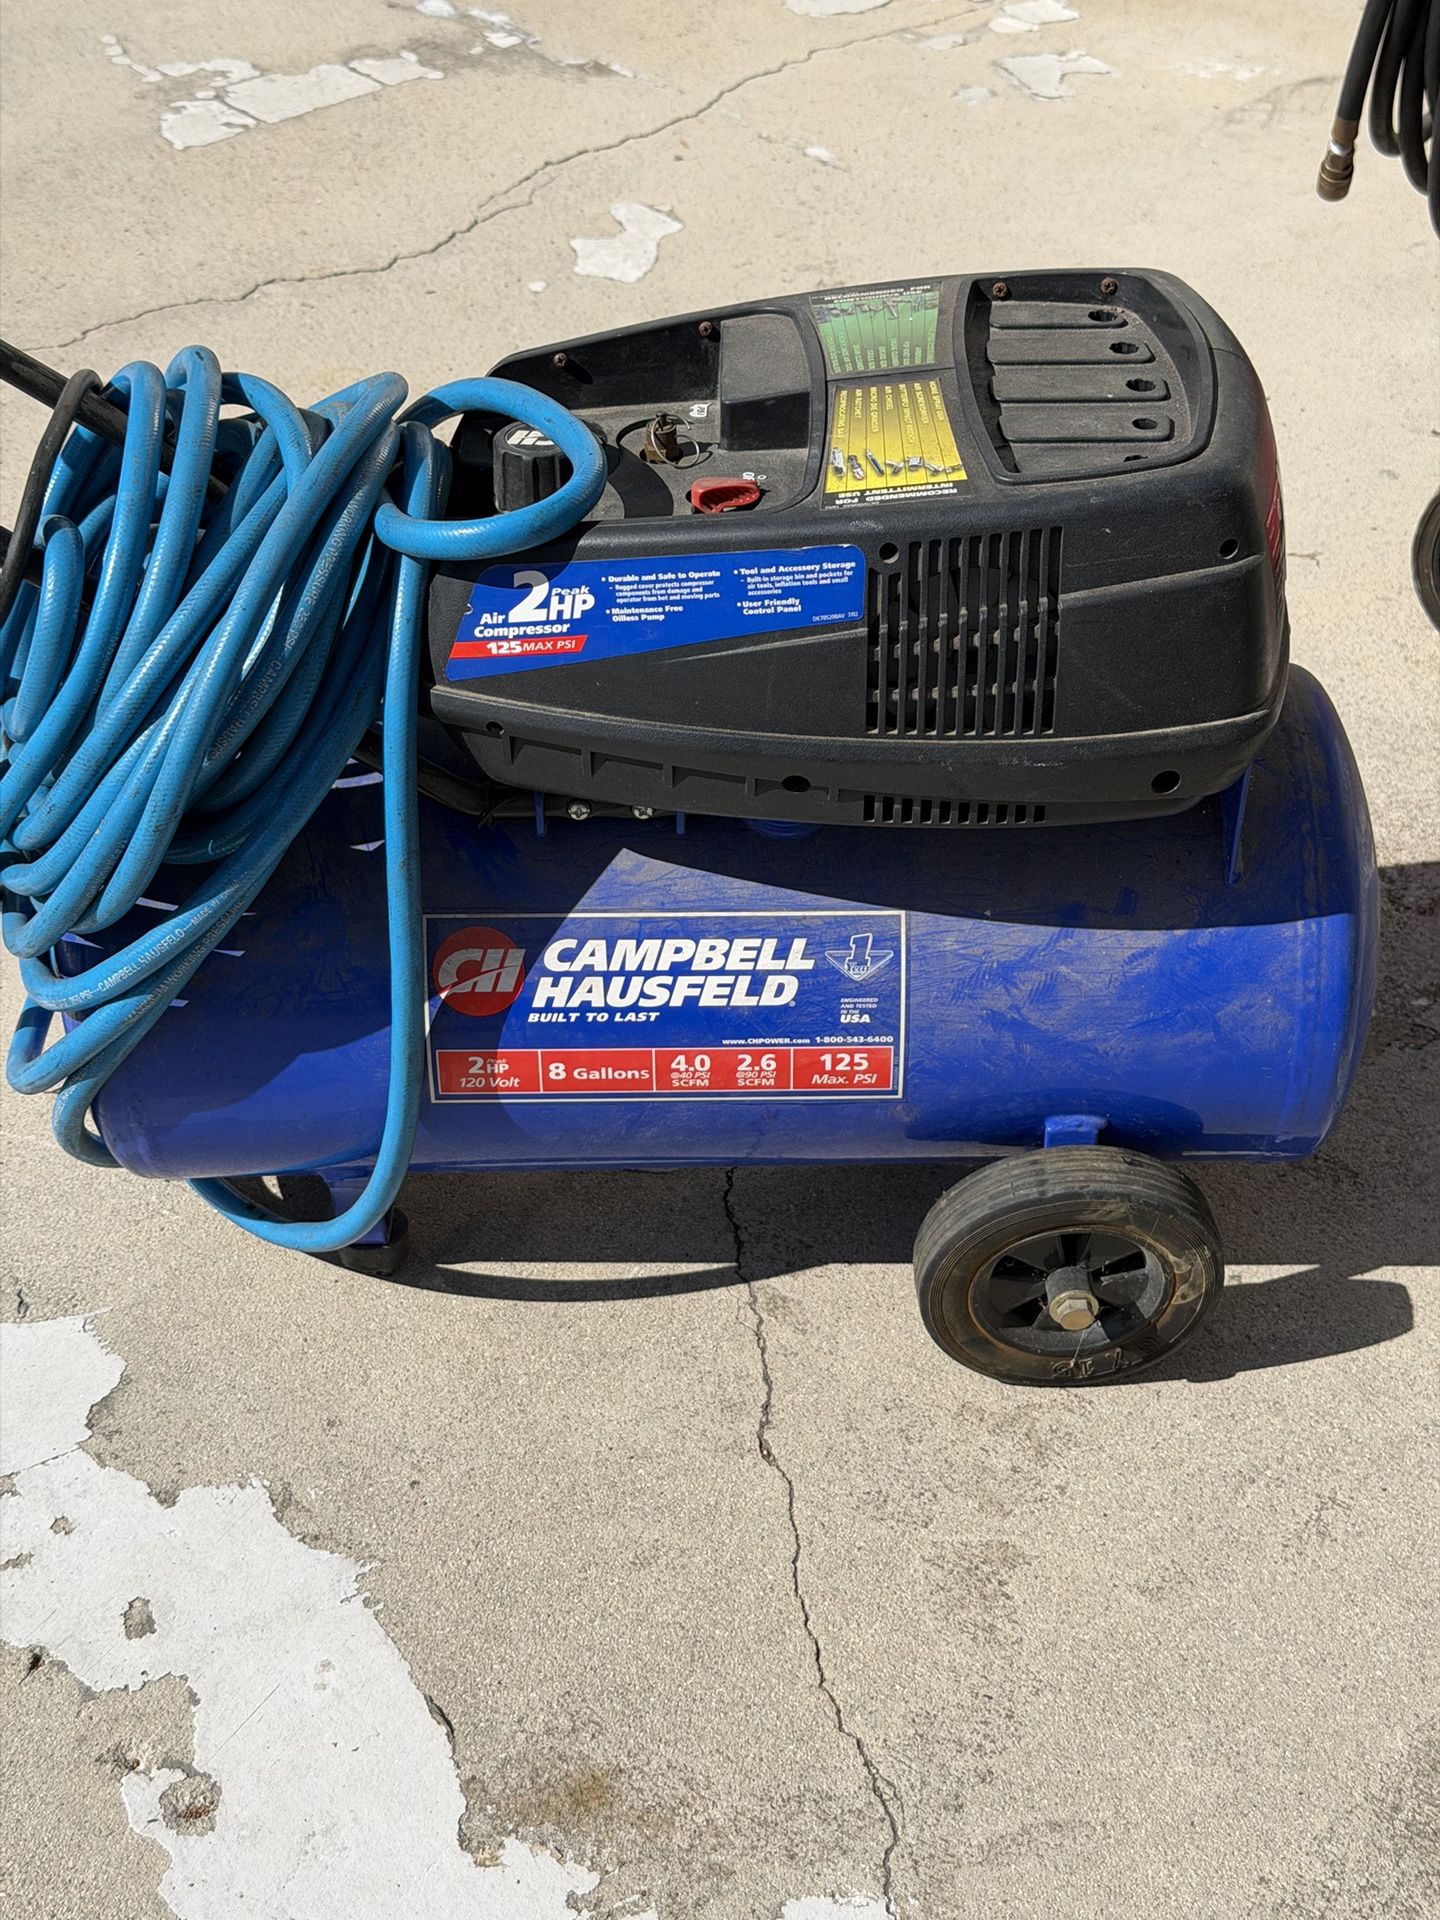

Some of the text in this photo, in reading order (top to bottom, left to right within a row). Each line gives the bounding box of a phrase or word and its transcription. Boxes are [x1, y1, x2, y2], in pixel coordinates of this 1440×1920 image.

[864, 482, 953, 496] INTERMITTENT
[865, 488, 958, 502] RECOMMENDED
[739, 561, 856, 575] Tool and Accessory Storage
[608, 570, 721, 582] Durable and Safe to Operate
[819, 571, 842, 579] pockets
[774, 580, 800, 588] inflation
[508, 570, 590, 623] 2 Peak
[748, 588, 782, 596] accessories
[549, 594, 595, 620] HP
[742, 597, 800, 608] User Friendly
[611, 606, 663, 615] Maintenance
[743, 605, 802, 615] Control Panel
[480, 612, 506, 625] Air
[641, 614, 665, 622] Pump
[474, 623, 570, 639] Compressor
[486, 640, 576, 654] 125 MAX PSI
[543, 938, 816, 972] CAMPBELL
[164, 945, 205, 984] WORKING
[438, 948, 526, 993] CH
[532, 975, 799, 1008] HAUSFELD
[528, 1012, 660, 1022] BUILT TO LAST
[840, 1014, 870, 1023] USA
[722, 1036, 894, 1045] www.CHPOWER.com 1-800-543-6400
[468, 1057, 484, 1074] 2
[670, 1054, 711, 1071] 4.0
[737, 1053, 777, 1071] 2.6
[819, 1053, 869, 1070] 125
[486, 1064, 510, 1073] HP
[549, 1063, 650, 1080] 8 Gallons
[694, 1071, 711, 1079] PSI
[811, 1074, 877, 1085] Max. PSI
[460, 1077, 520, 1088] 120 Volt
[672, 1078, 709, 1087] SCFM
[737, 1078, 774, 1086] SCFM
